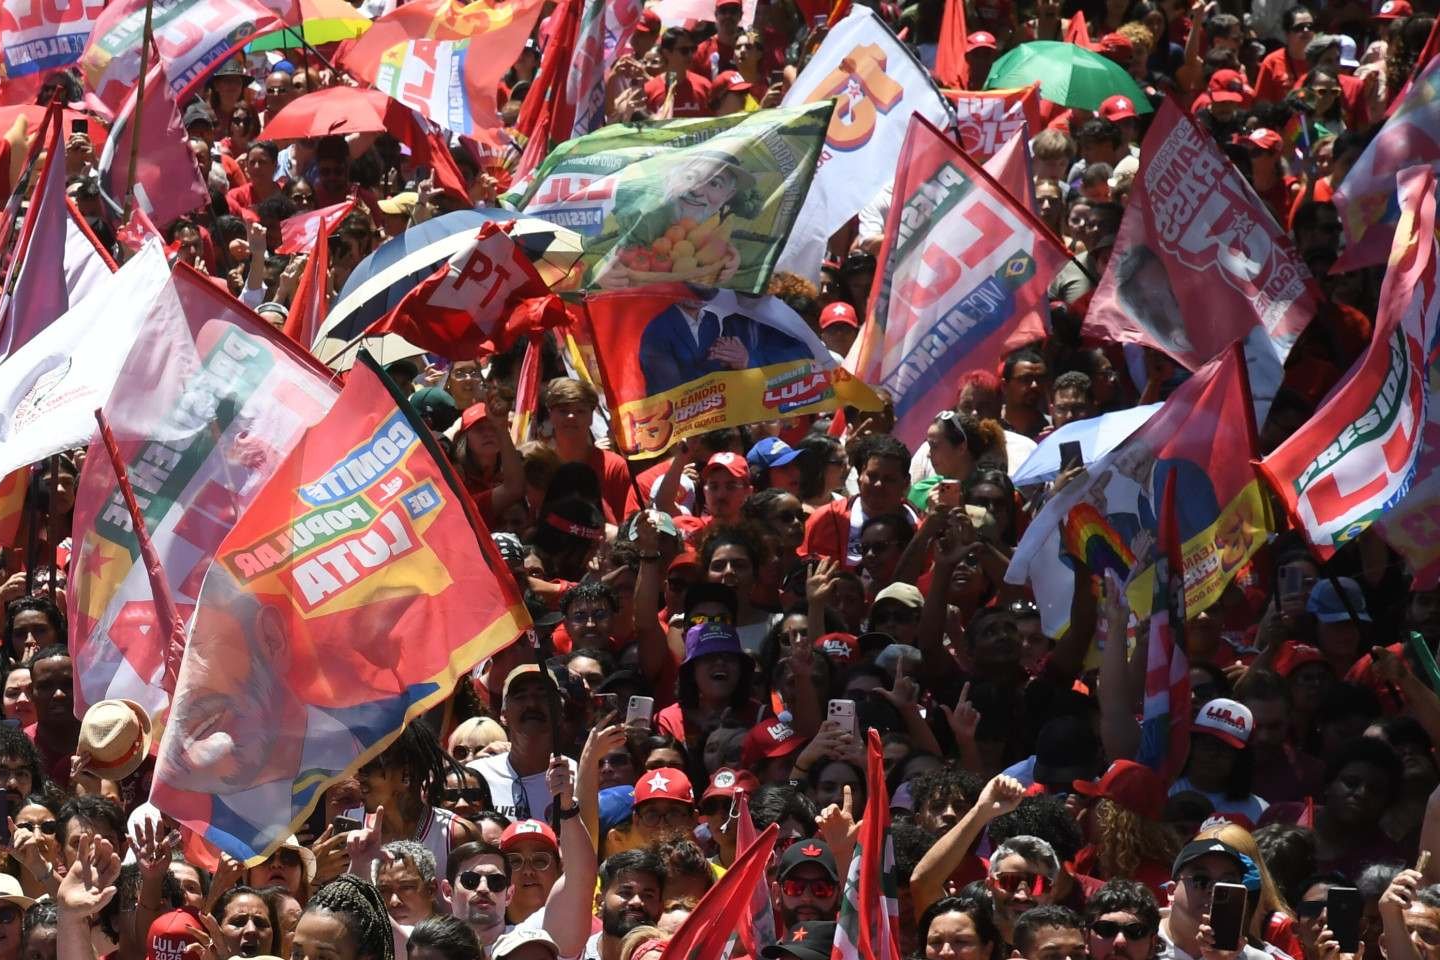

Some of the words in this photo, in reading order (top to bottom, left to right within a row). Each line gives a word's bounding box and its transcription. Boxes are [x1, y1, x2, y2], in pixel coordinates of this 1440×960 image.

[453, 248, 511, 309] PT
[674, 383, 726, 409] LEANDRO
[764, 374, 827, 401] LULA
[1206, 706, 1245, 728] LULA
[152, 935, 187, 953] LULA
